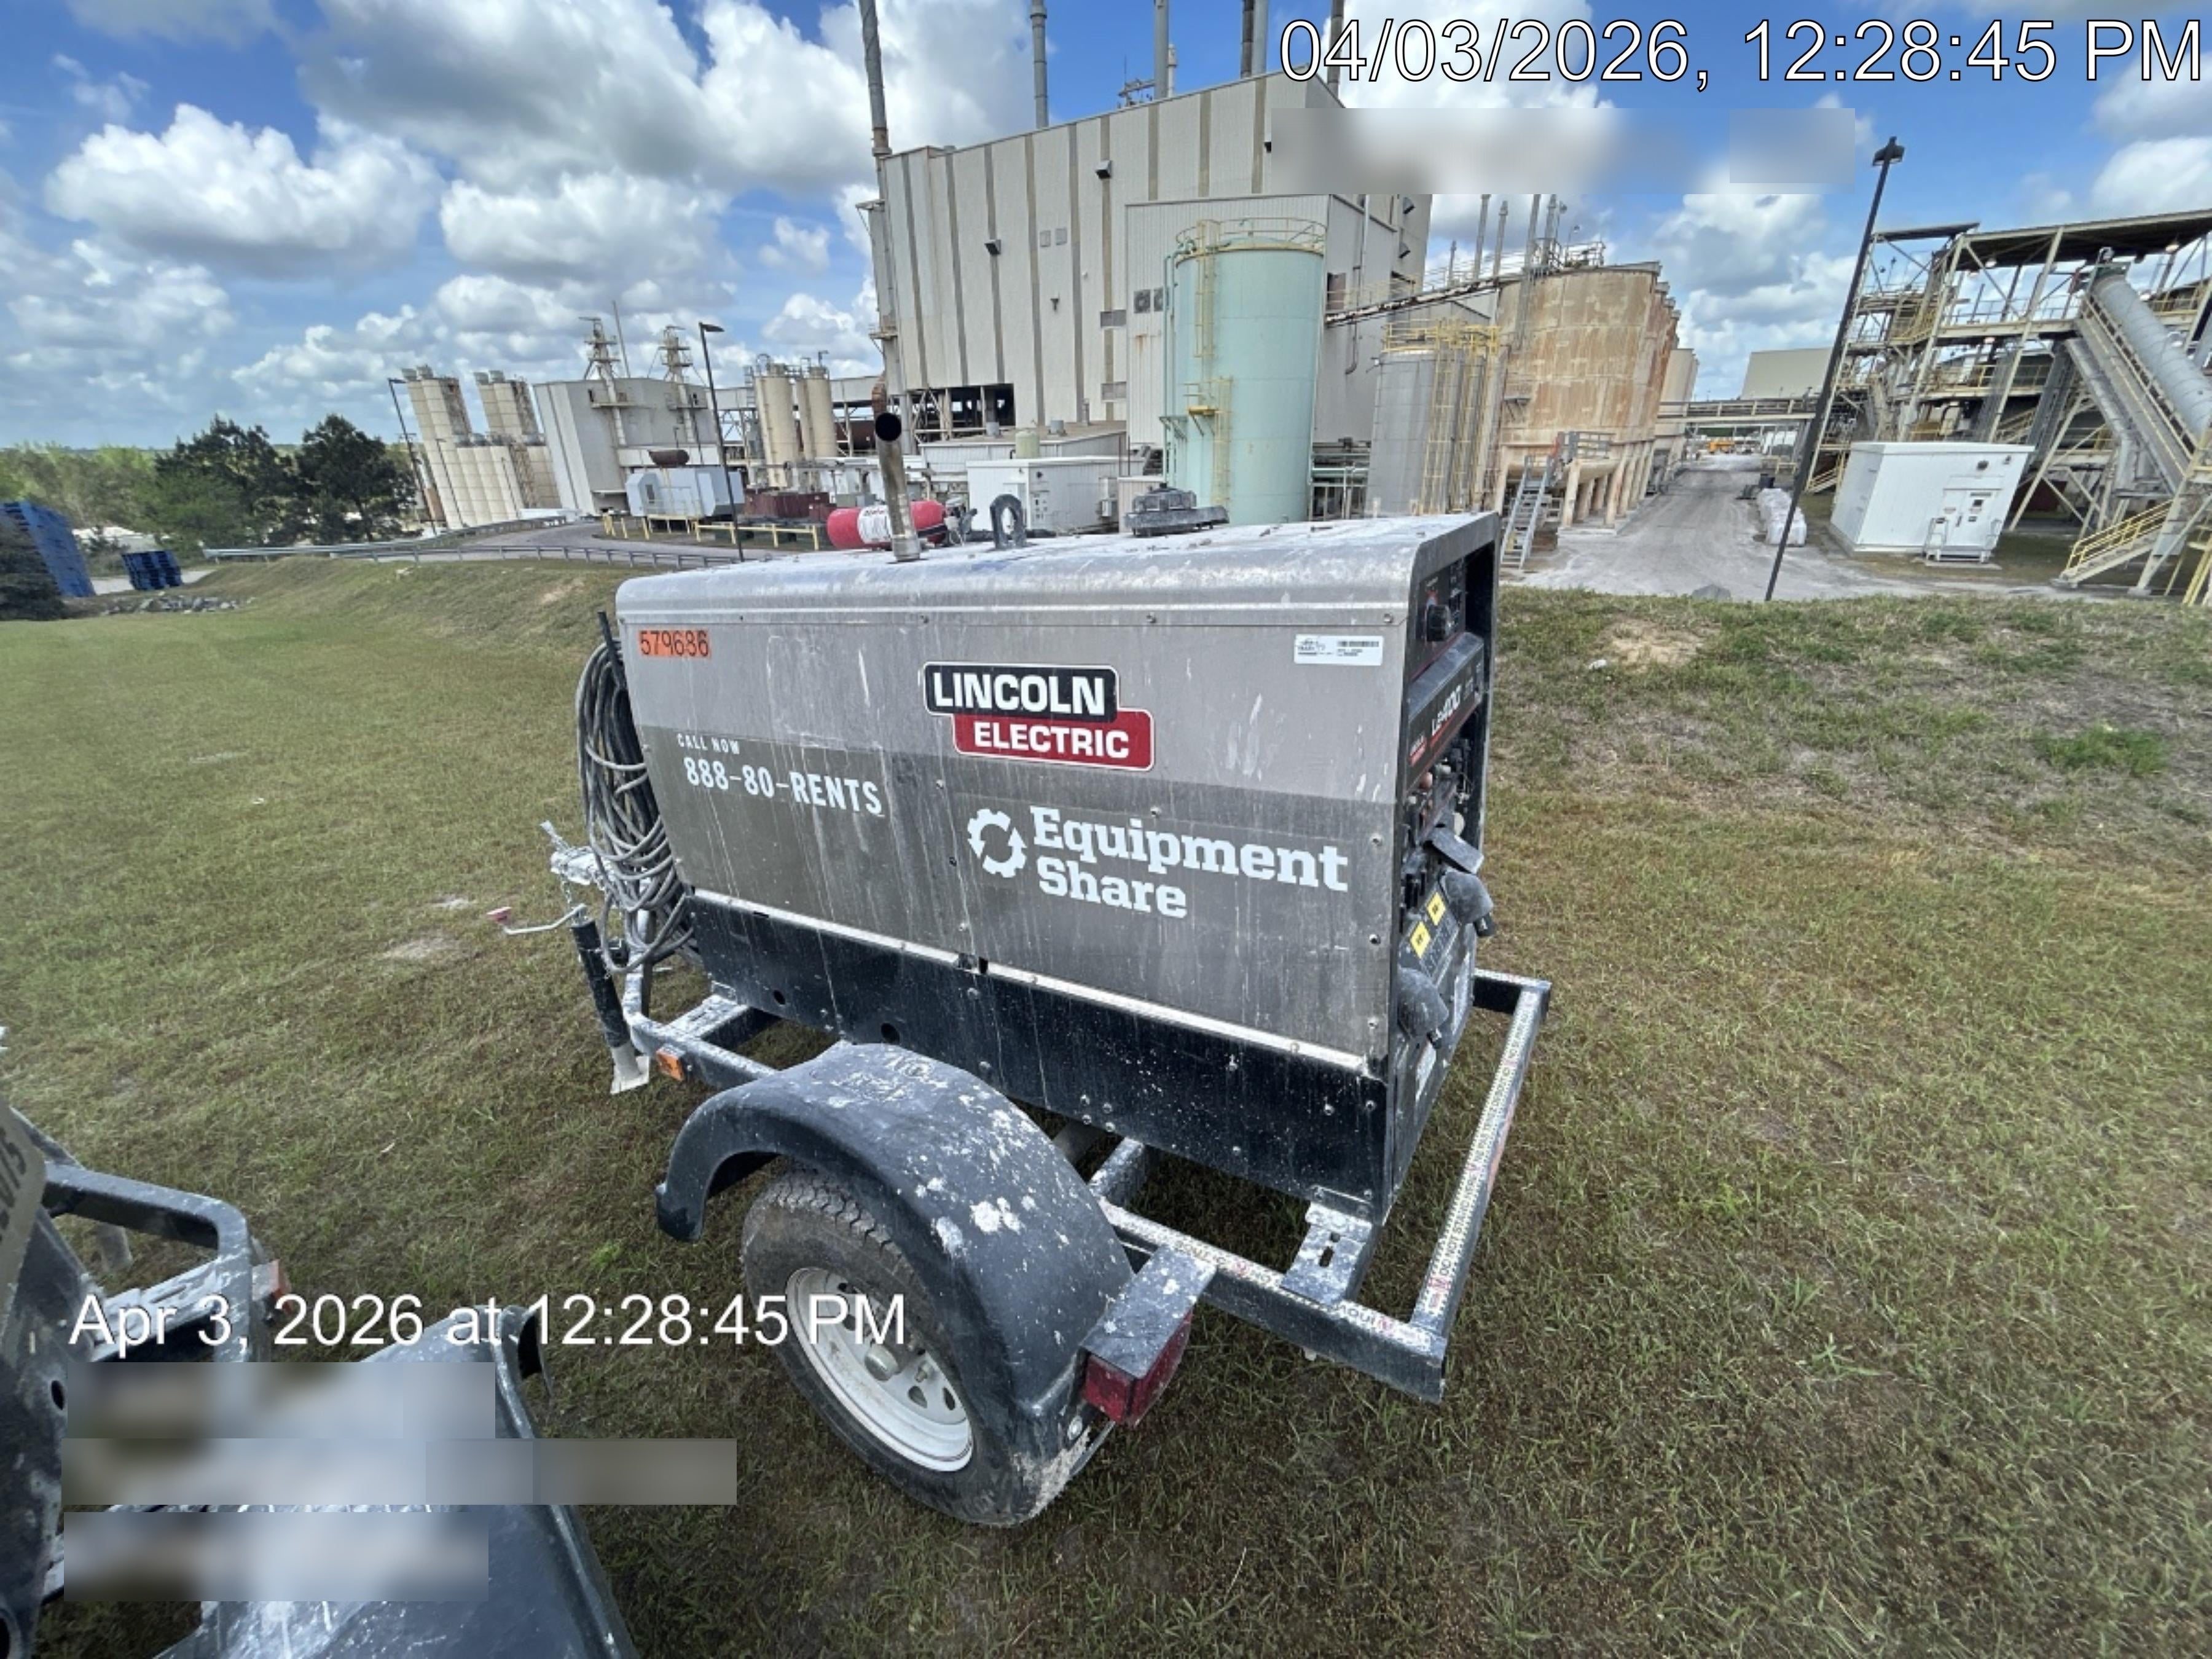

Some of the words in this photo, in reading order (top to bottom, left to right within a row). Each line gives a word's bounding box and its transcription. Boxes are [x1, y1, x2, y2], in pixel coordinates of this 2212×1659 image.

[640, 630, 708, 657] 579686
[933, 672, 1105, 715] LINCOLN
[678, 733, 708, 750] CALL
[711, 737, 740, 755] NOW
[974, 721, 1129, 759] ELECTRIC
[683, 756, 882, 815] 888-80-RENTS
[1030, 806, 1348, 892] Equipment
[1037, 856, 1187, 918] Share
